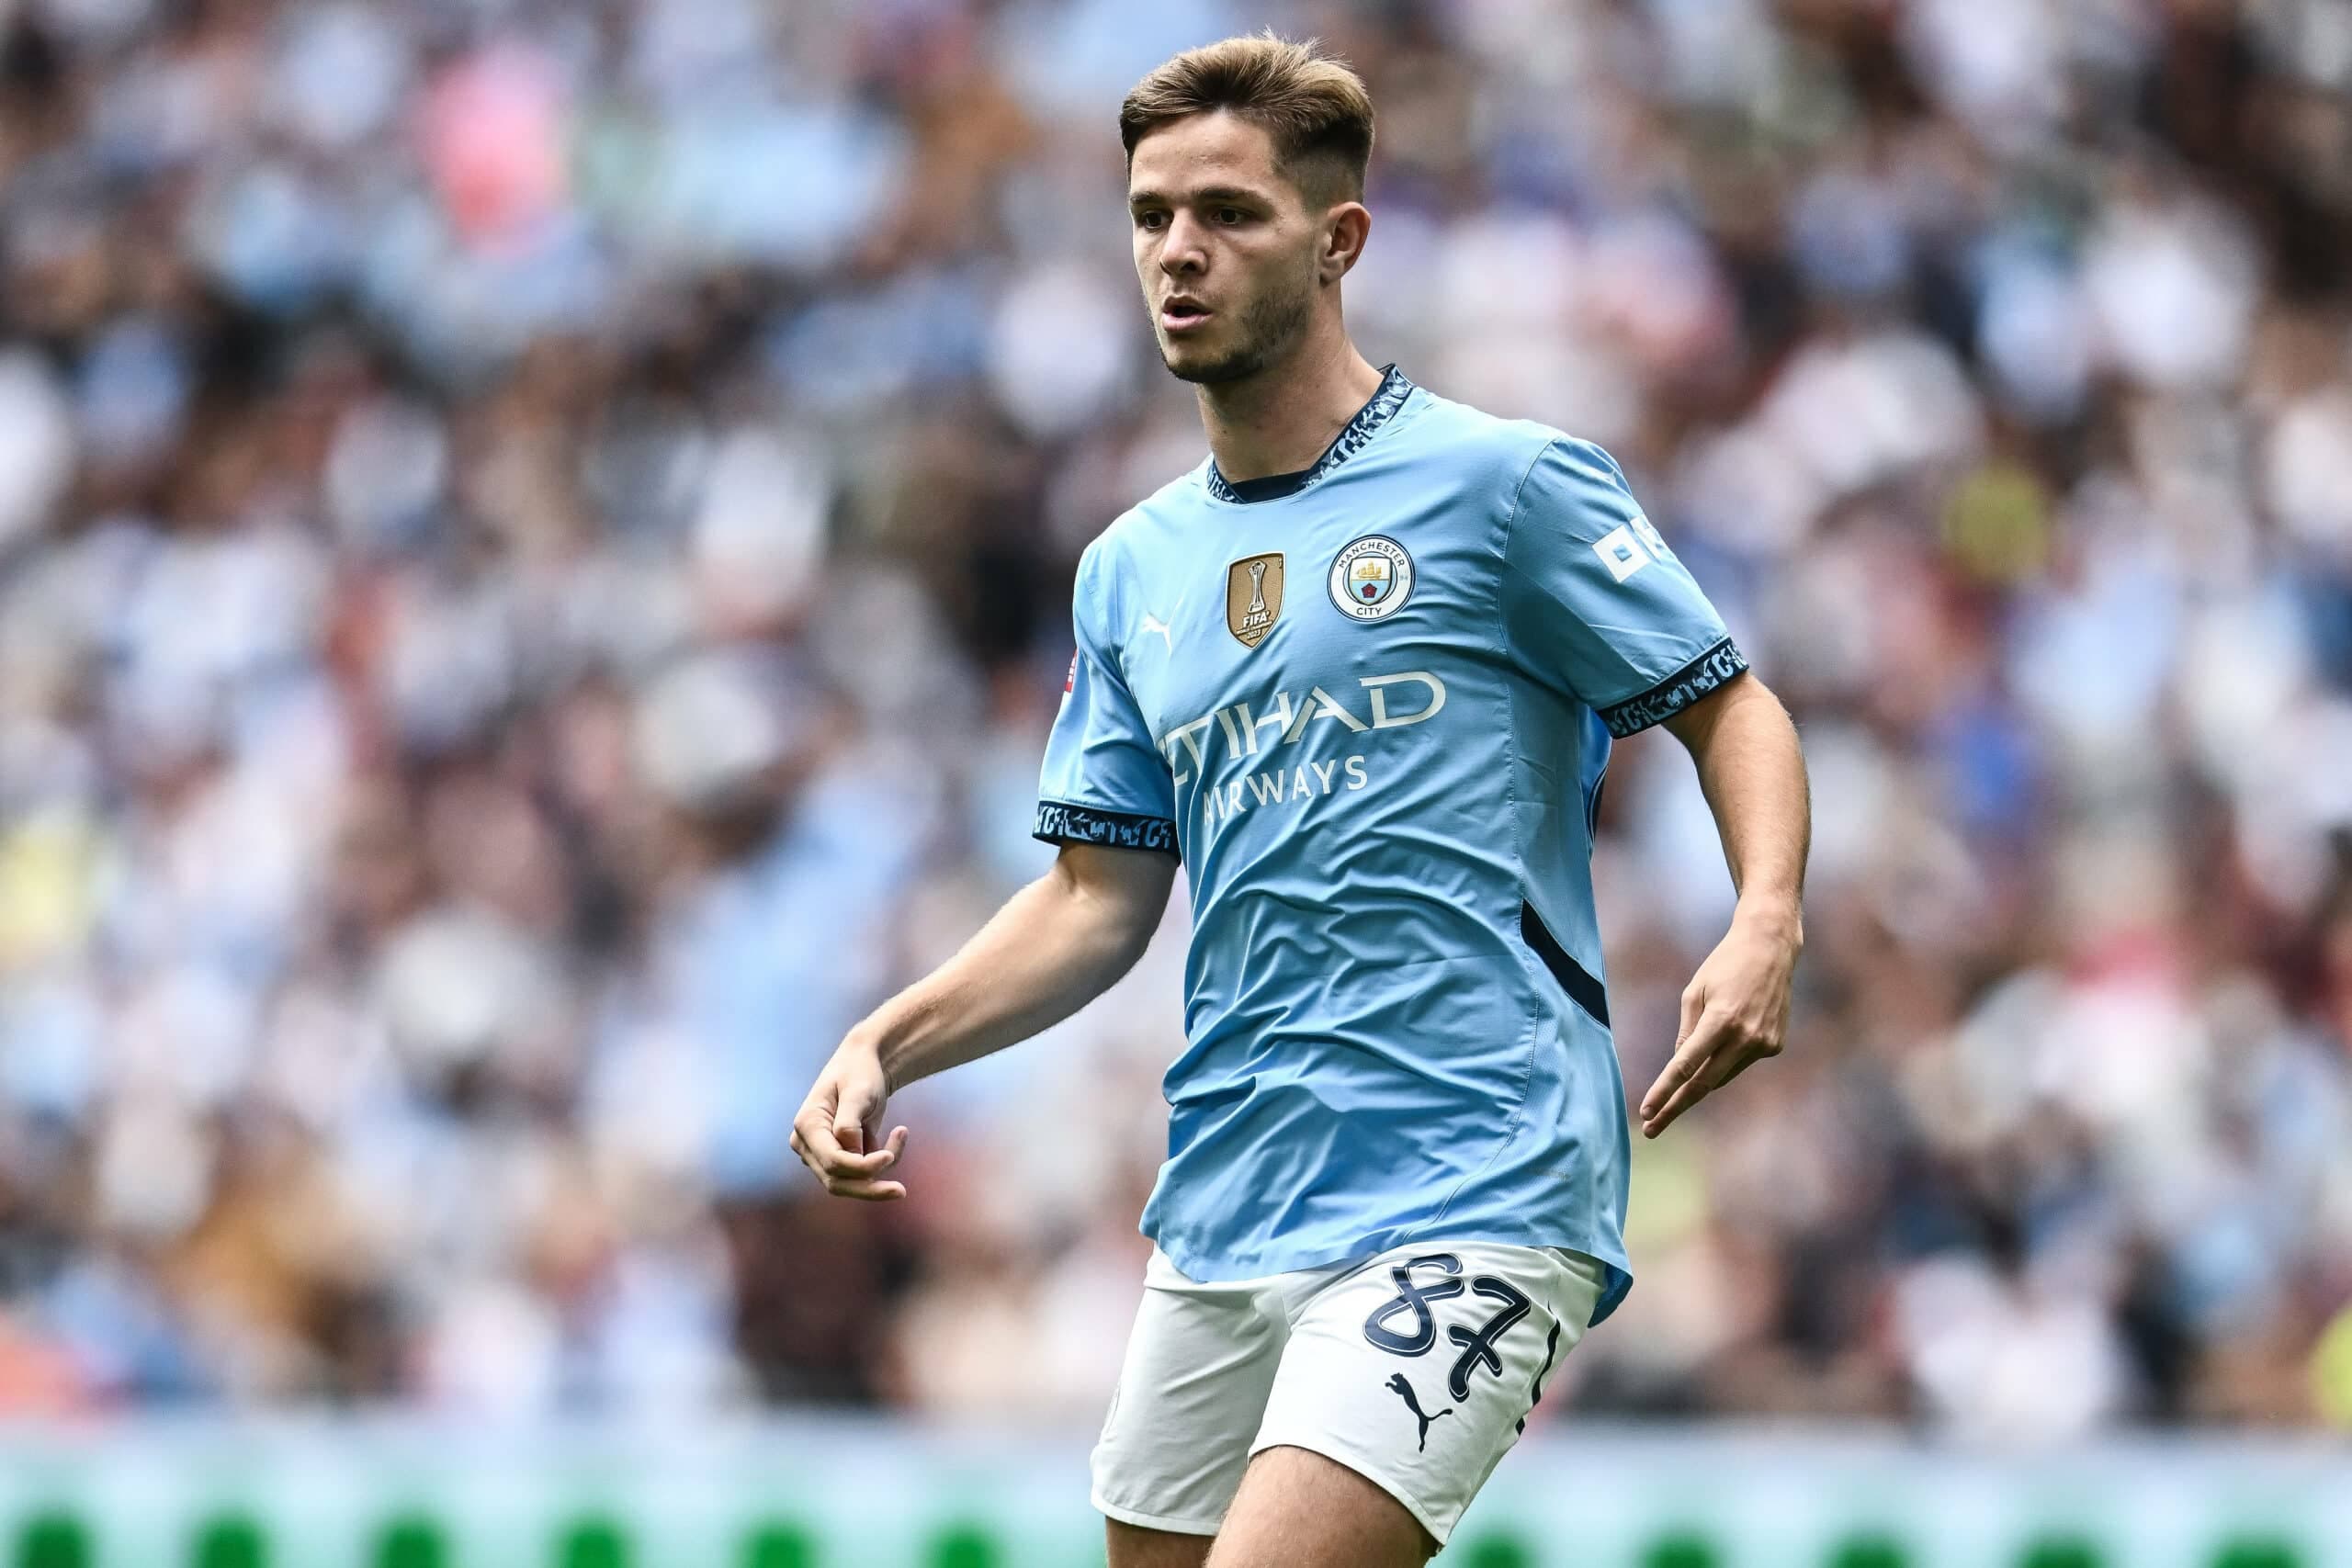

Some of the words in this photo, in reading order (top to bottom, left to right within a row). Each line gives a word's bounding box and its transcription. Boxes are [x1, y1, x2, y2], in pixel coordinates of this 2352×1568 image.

[1338, 541, 1406, 569] MANCHESTER
[1243, 611, 1268, 627] FIFA
[1356, 607, 1382, 615] CITY
[1203, 755, 1368, 826] AIRWAYS
[1363, 1252, 1532, 1403] 87
